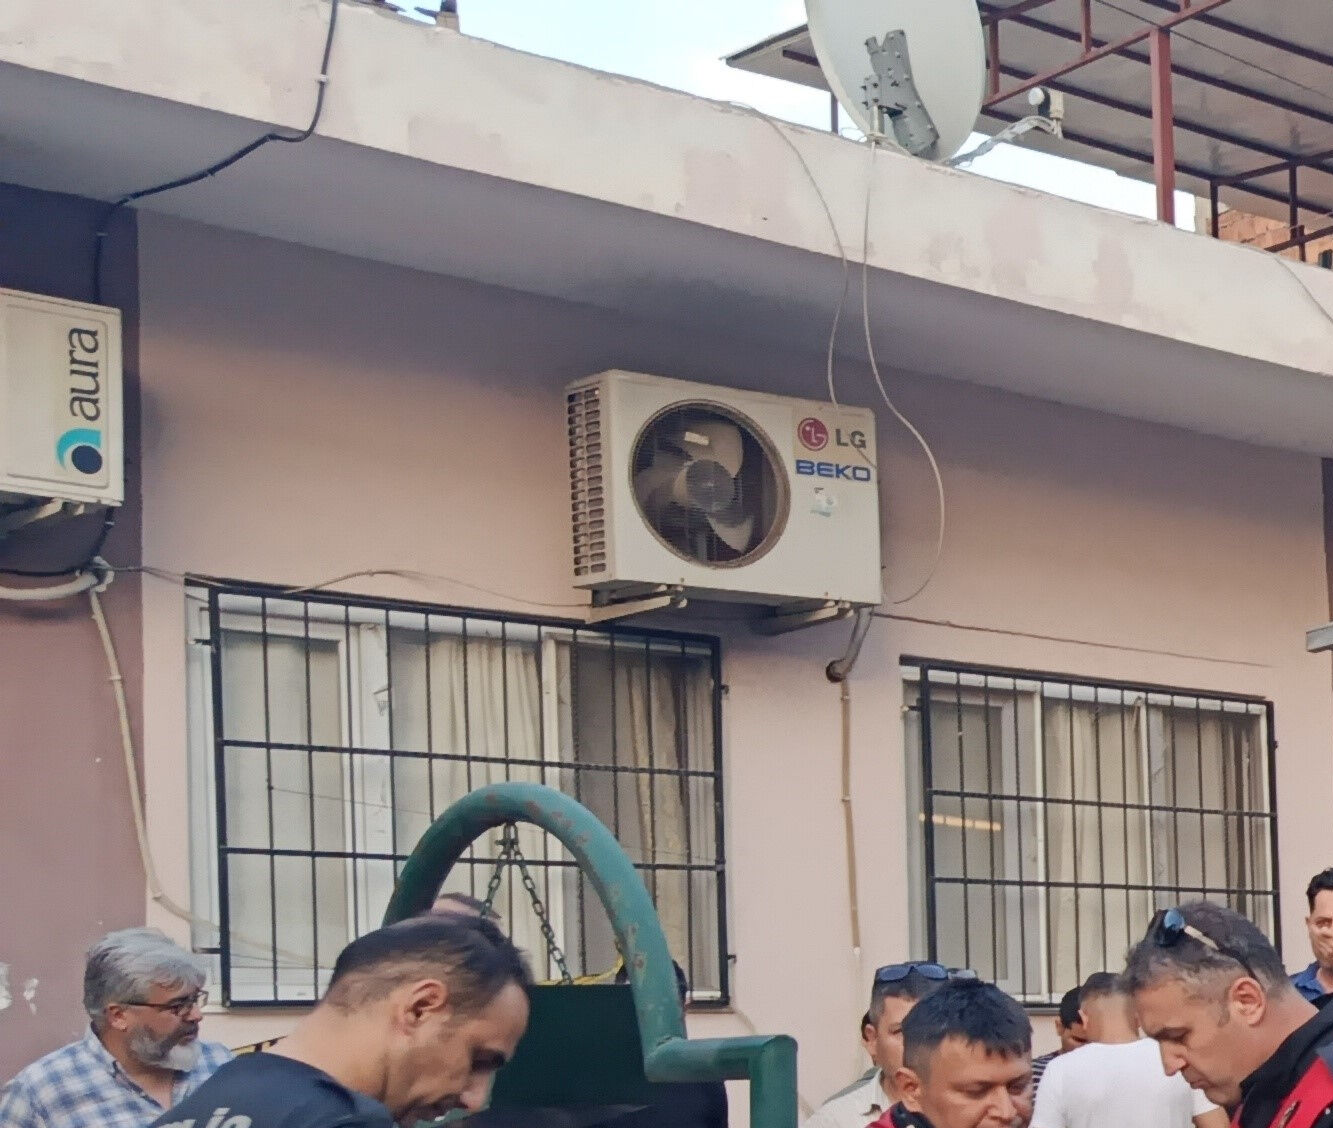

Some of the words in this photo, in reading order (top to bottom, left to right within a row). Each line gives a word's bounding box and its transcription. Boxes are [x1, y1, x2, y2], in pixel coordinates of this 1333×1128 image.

[68, 327, 101, 422] aura
[836, 428, 867, 448] LG
[796, 459, 871, 481] BEKO
